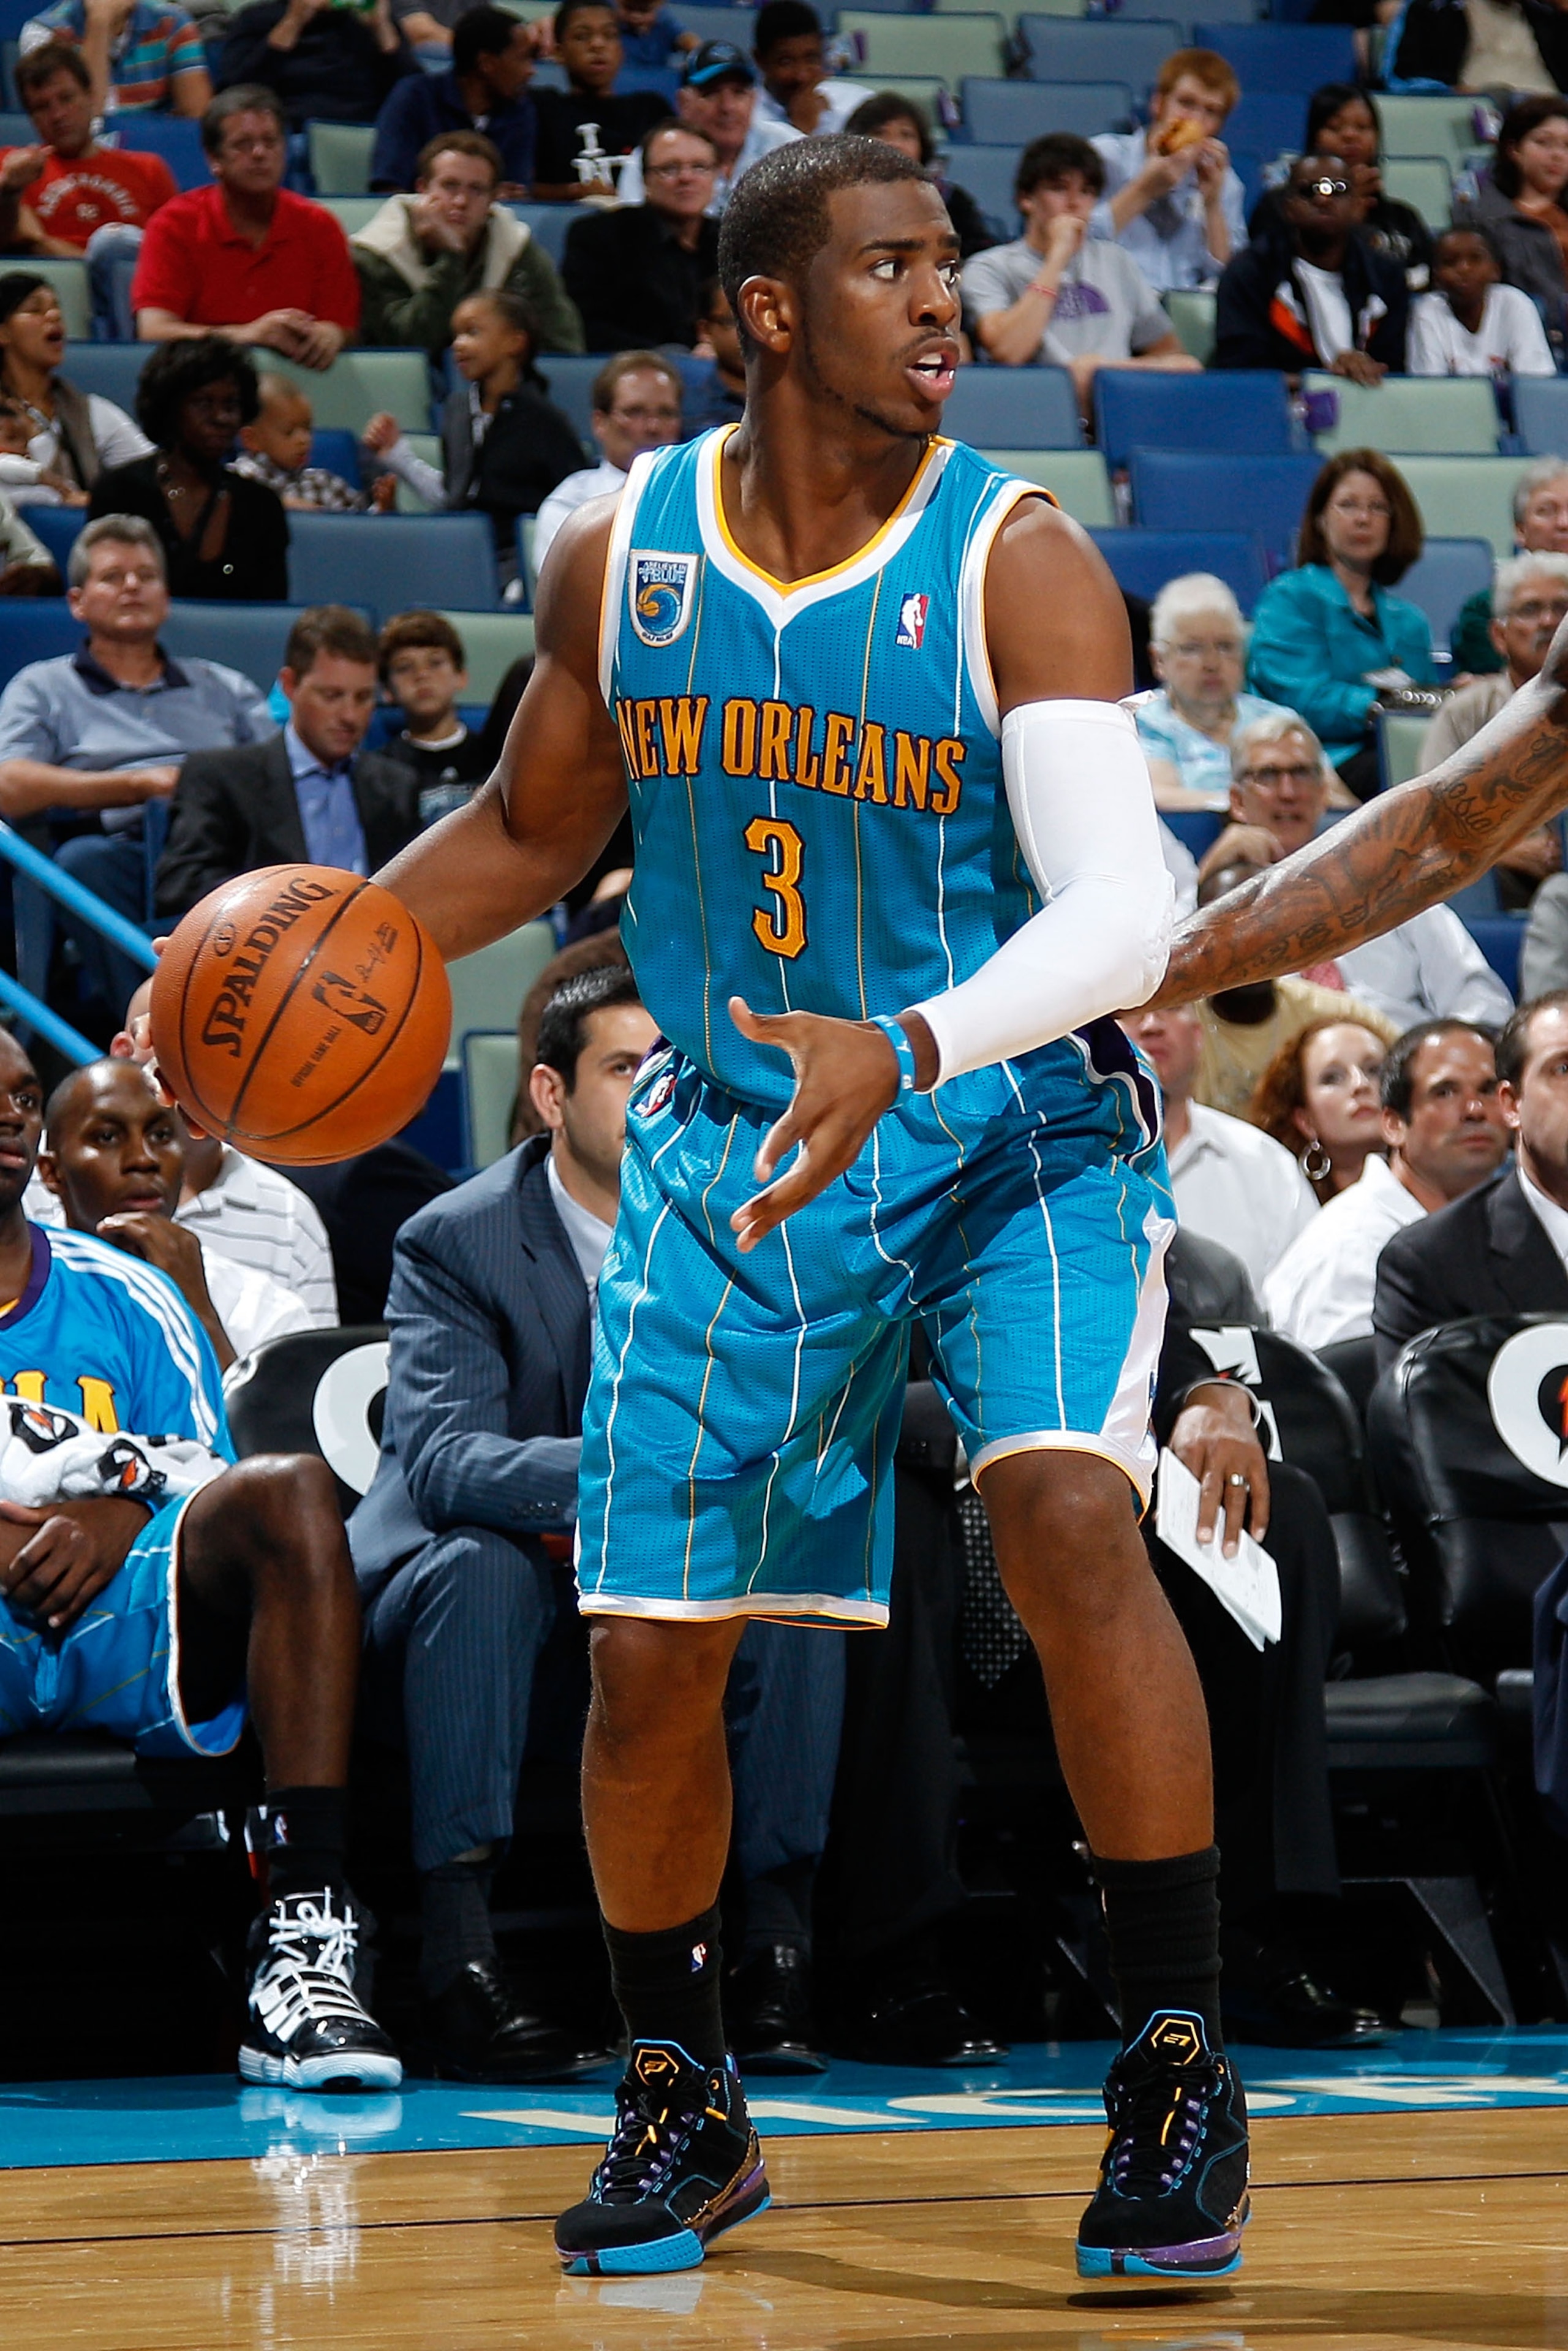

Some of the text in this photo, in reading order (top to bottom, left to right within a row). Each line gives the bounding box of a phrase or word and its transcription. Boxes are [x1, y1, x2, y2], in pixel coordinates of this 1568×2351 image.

[649, 568, 685, 584] BLUE
[896, 635, 913, 646] NBA
[614, 695, 968, 815] NEW ORLEANS
[742, 815, 809, 960] 3
[202, 877, 334, 1058] SPALDING
[323, 1025, 342, 1043] BALL
